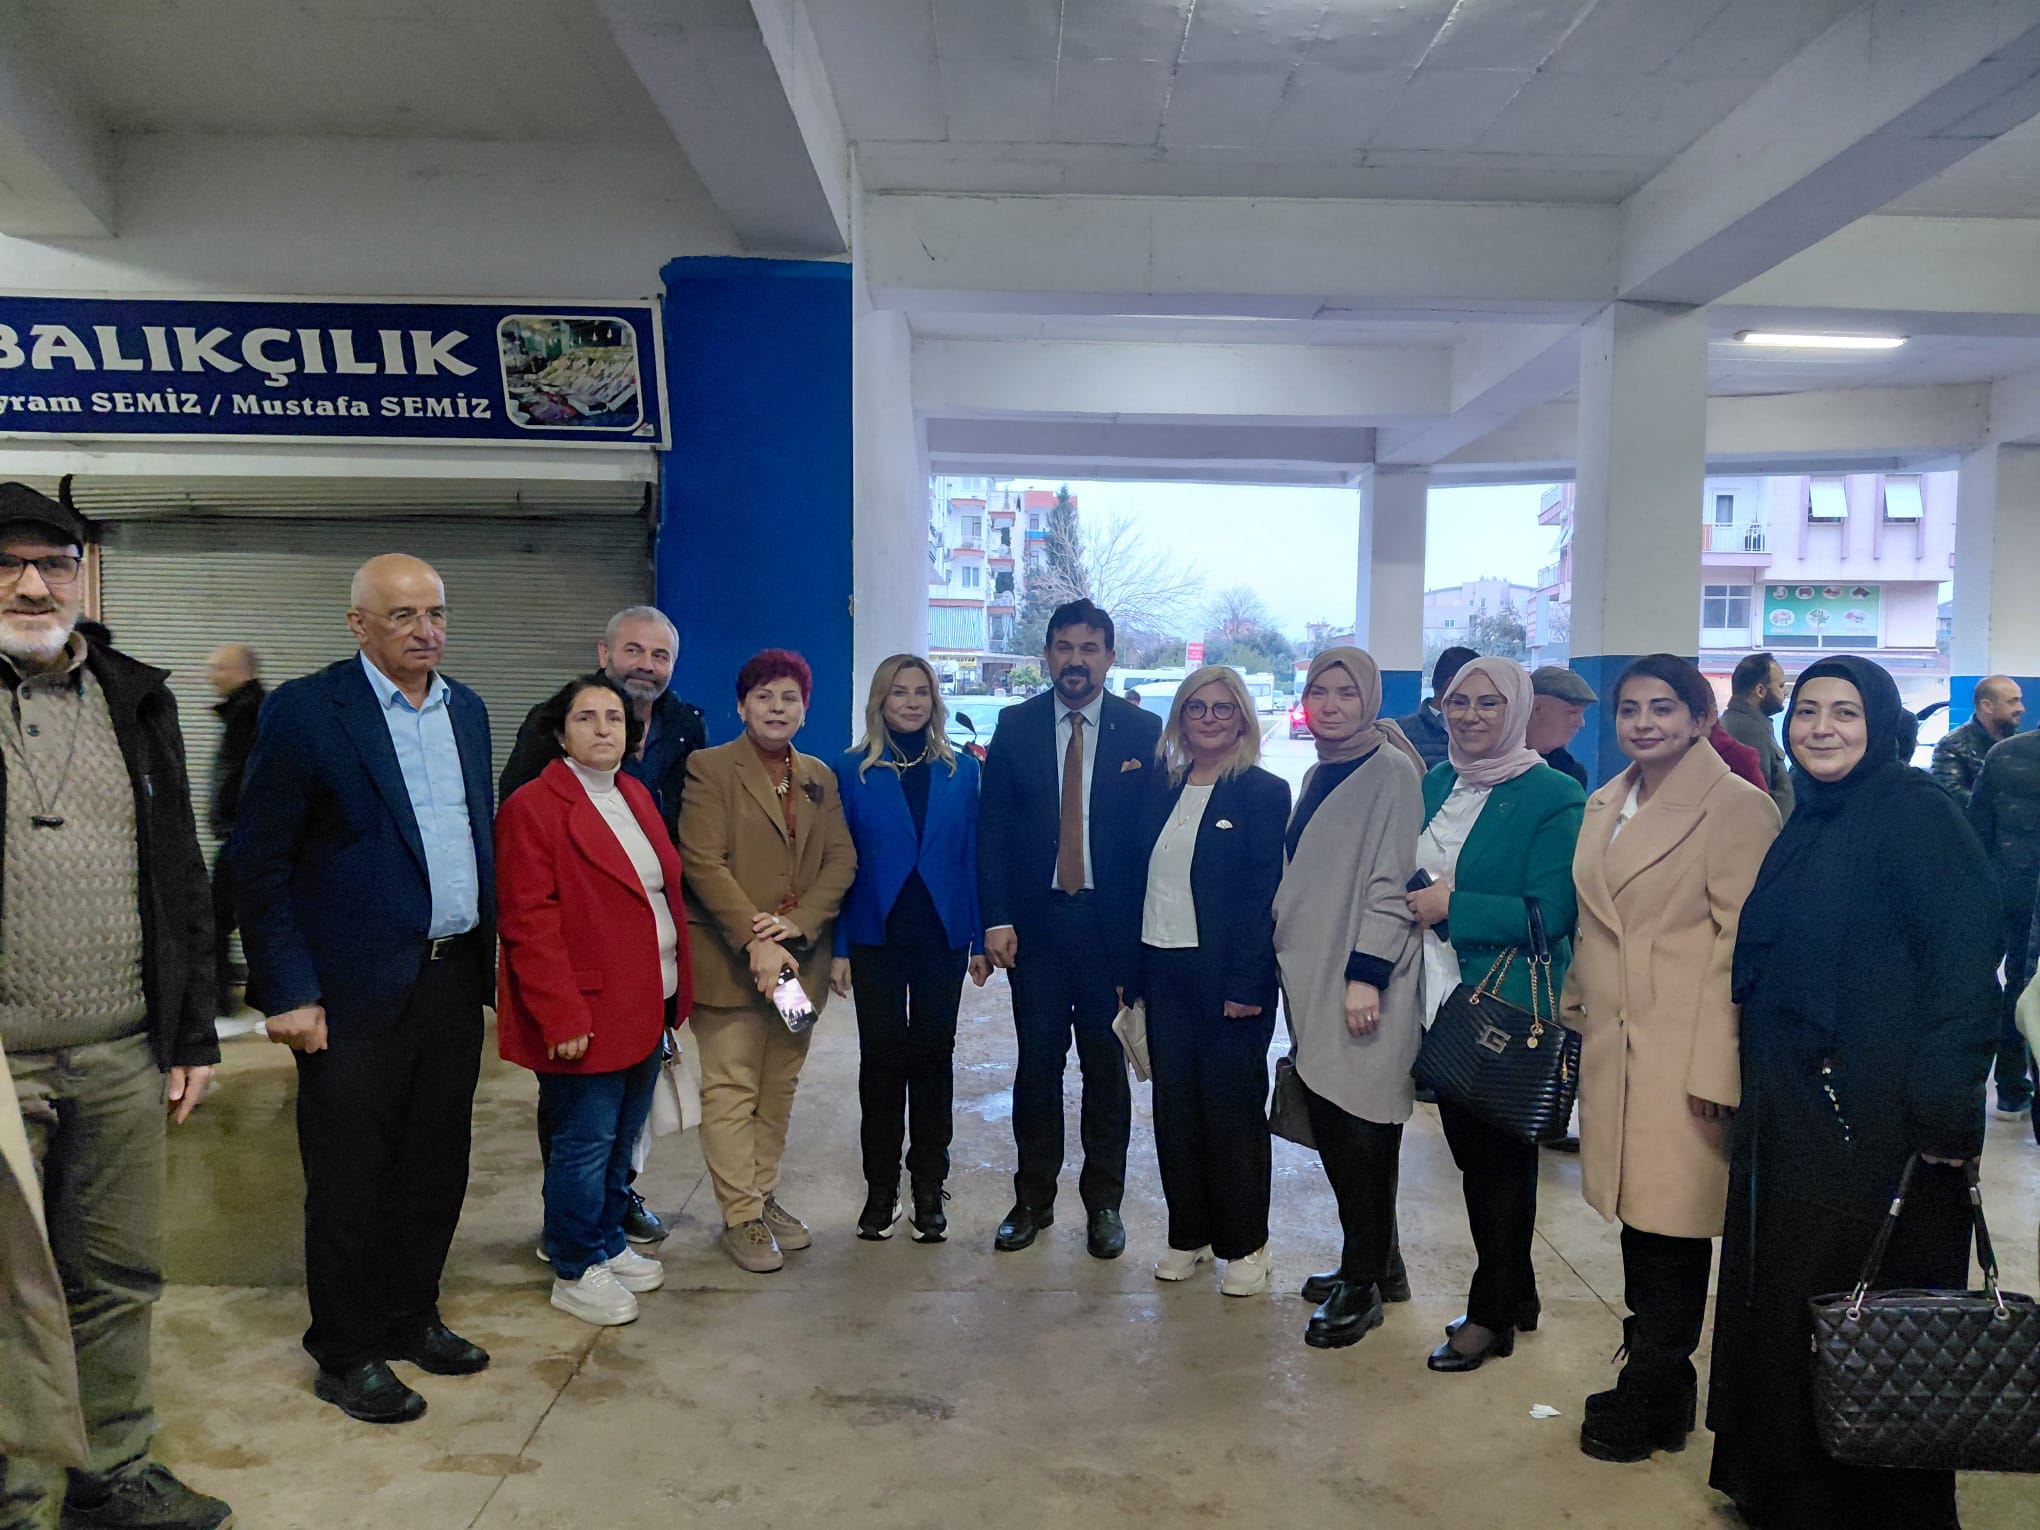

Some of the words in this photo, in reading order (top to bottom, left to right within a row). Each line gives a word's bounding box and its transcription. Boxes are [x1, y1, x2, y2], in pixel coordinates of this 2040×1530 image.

[91, 387, 202, 414] SEMİZ
[209, 393, 221, 416] /
[231, 394, 370, 417] Mustafa
[380, 392, 491, 419] SEMİZ
